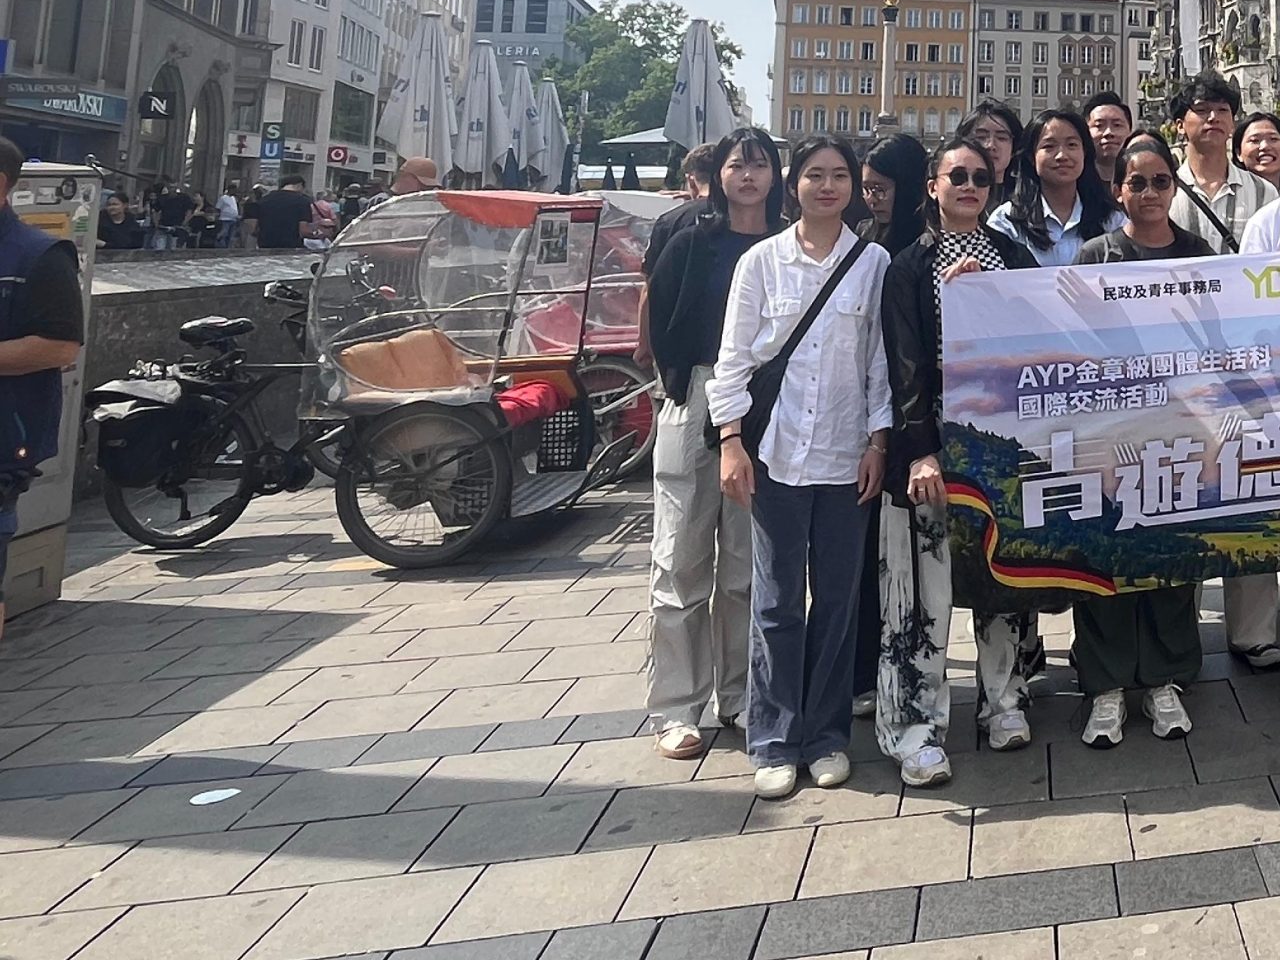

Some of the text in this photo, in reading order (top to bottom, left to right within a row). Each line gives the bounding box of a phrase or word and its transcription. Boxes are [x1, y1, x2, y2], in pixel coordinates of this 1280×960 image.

[497, 46, 540, 56] LERIA
[8, 83, 76, 93] SWAROVSKI
[266, 124, 281, 139] S
[264, 143, 278, 157] U
[1103, 280, 1222, 301] 民政及青年事務局
[1017, 345, 1272, 390] AYP金章級團體生活科
[1017, 382, 1169, 420] 國際交流活動
